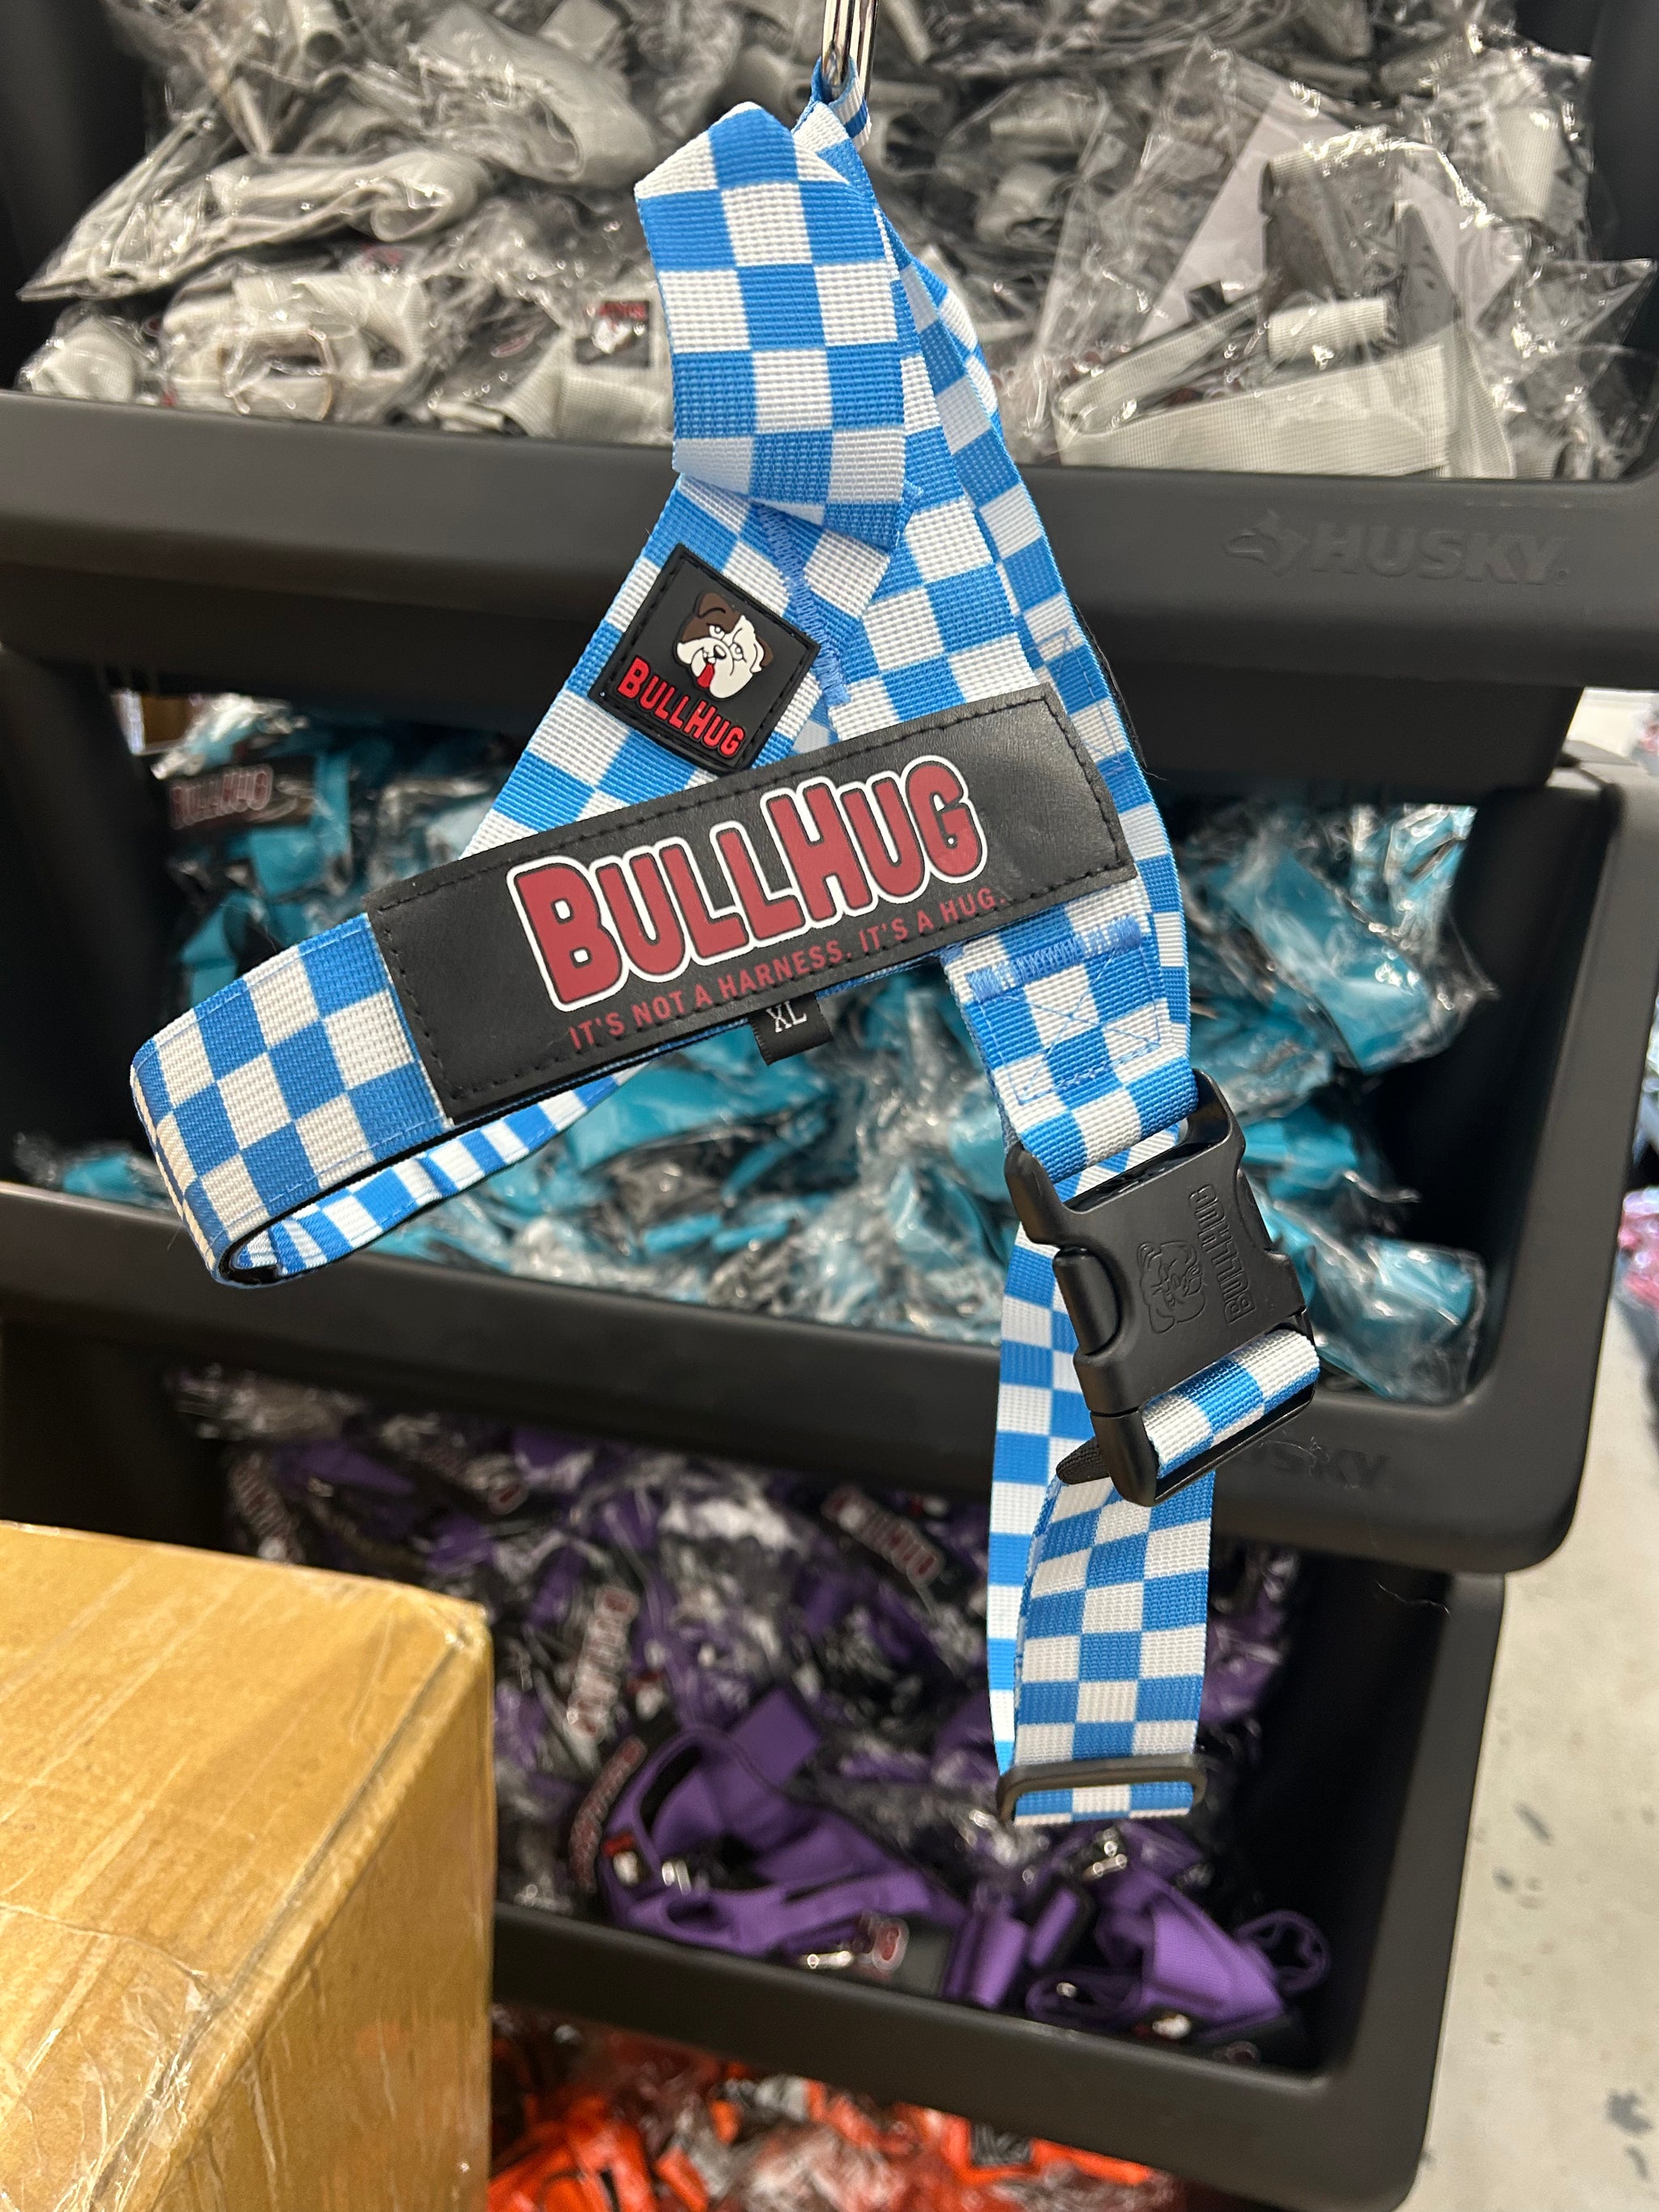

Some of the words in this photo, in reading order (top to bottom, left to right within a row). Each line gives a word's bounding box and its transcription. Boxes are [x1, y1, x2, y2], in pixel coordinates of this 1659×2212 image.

[1310, 521, 1568, 586] HUSKY
[617, 655, 744, 757] BULLHUG
[506, 755, 988, 1012] BULLHUG
[568, 1012, 625, 1051] IT'S
[631, 990, 685, 1028] NOT
[693, 984, 714, 1009] A
[717, 940, 851, 1000] HARNESS.
[859, 918, 909, 953] IT'S
[917, 910, 935, 933] A
[939, 887, 1007, 924] HUG.
[766, 1000, 808, 1033] XL
[1188, 1183, 1257, 1326] BULLHUG
